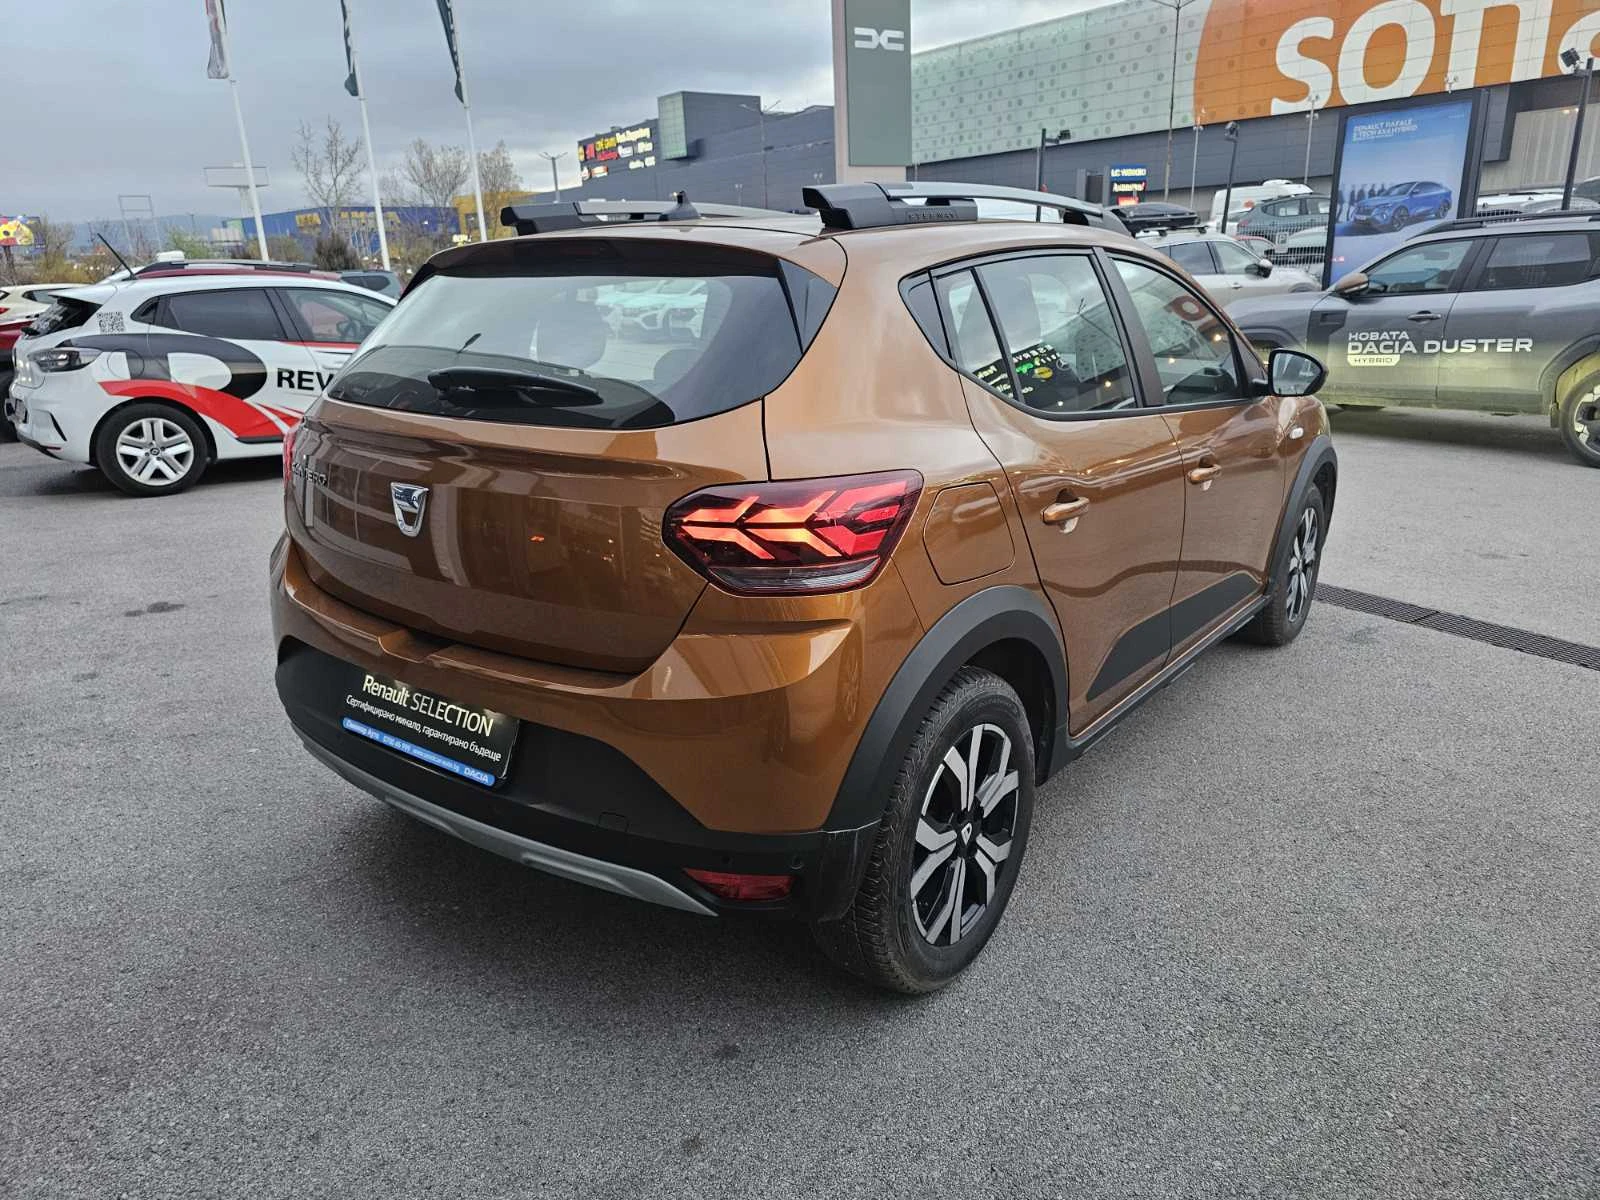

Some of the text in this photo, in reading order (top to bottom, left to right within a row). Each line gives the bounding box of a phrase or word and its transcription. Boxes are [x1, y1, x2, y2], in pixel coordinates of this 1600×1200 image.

[1347, 338, 1533, 354] DACIA DUSTER
[362, 674, 410, 707] Renault
[410, 692, 494, 737] SELECTION
[422, 725, 469, 750] гарантирано
[469, 741, 502, 762] бъдеще
